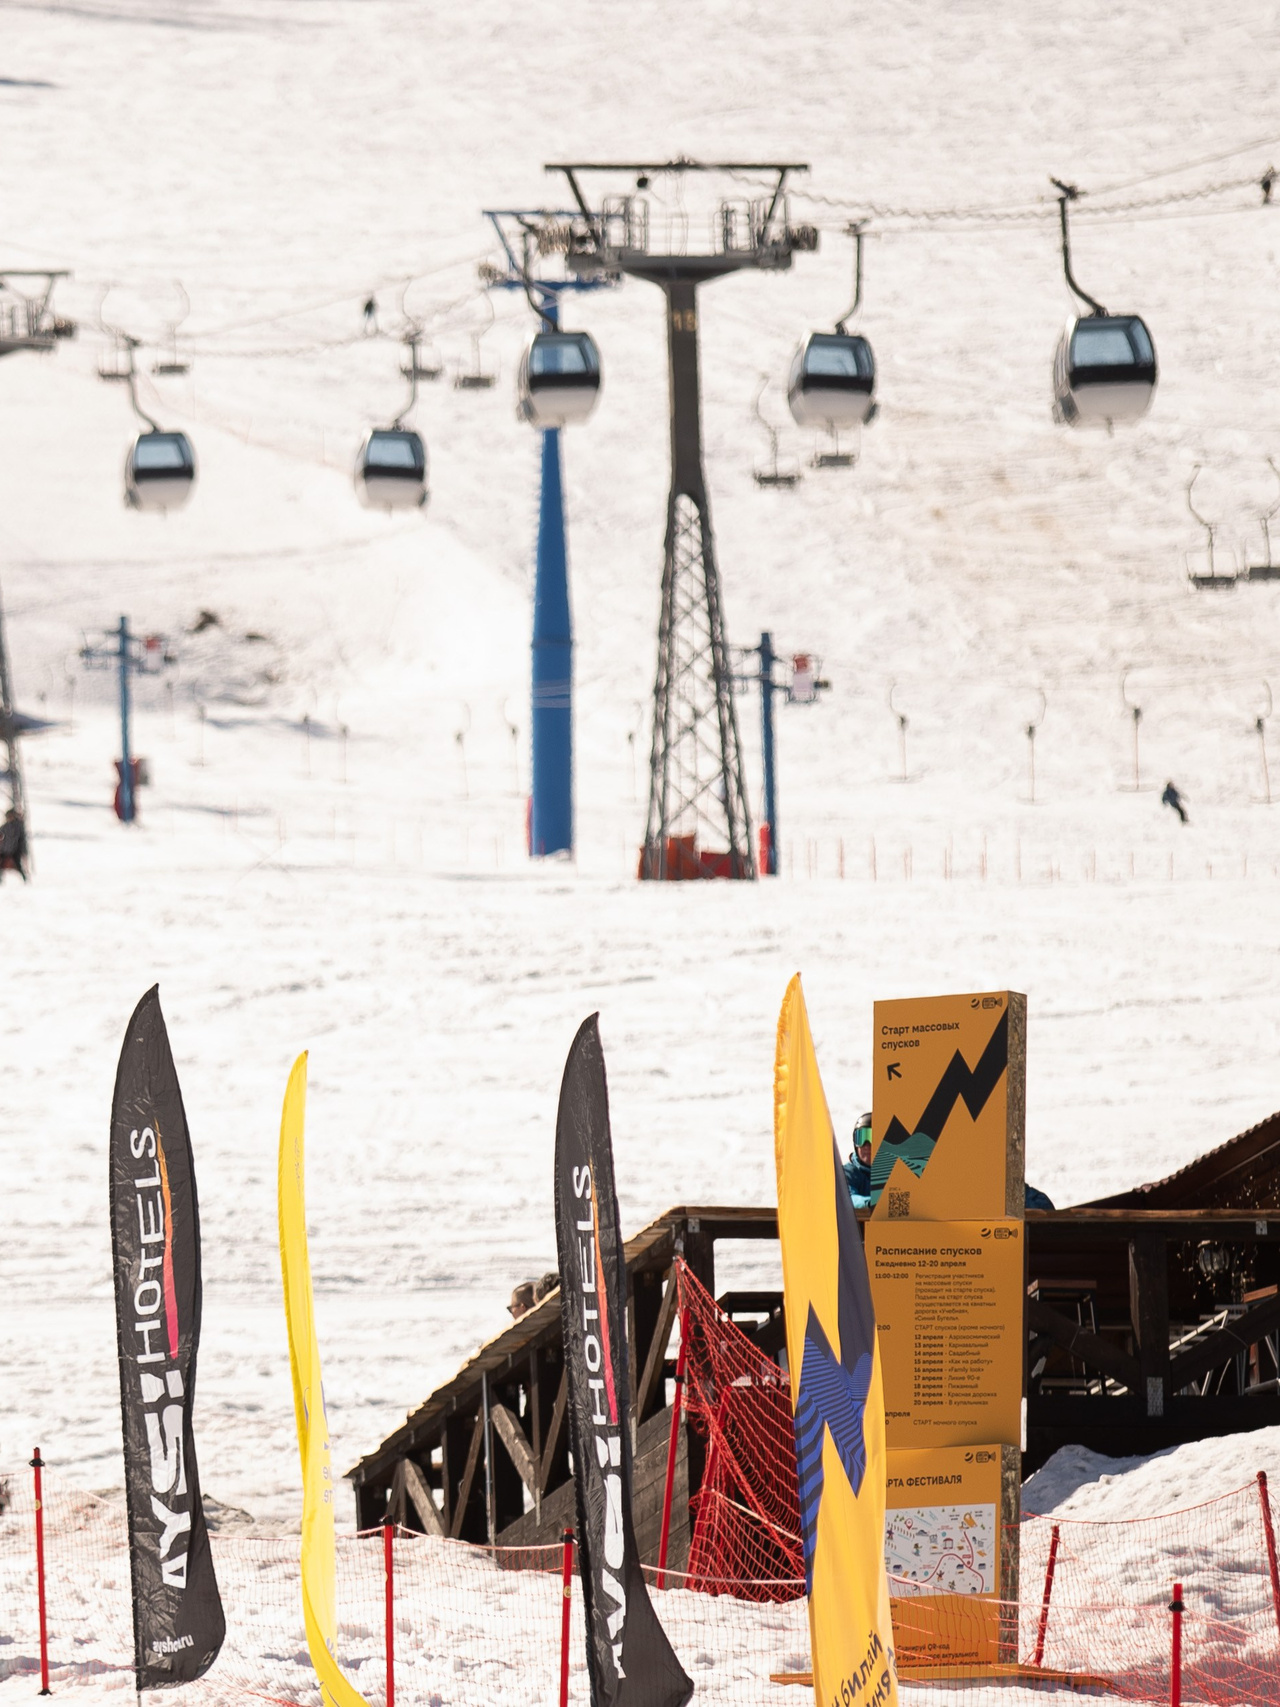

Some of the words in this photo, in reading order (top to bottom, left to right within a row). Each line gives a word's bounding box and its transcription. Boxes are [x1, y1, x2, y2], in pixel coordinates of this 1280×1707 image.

[881, 1024, 909, 1037] Старт
[912, 1021, 960, 1034] массовых
[881, 1039, 920, 1052] спусков
[130, 1124, 165, 1364] HOTELS
[875, 1246, 937, 1256] Расписание
[940, 1247, 982, 1257] спусков
[875, 1260, 916, 1268] Ежедневно
[572, 1163, 607, 1426] HOTELS
[886, 1478, 904, 1488] РТА
[906, 1475, 962, 1487] ФЕСТИВАЛЯ
[942, 1652, 978, 1660] актуального
